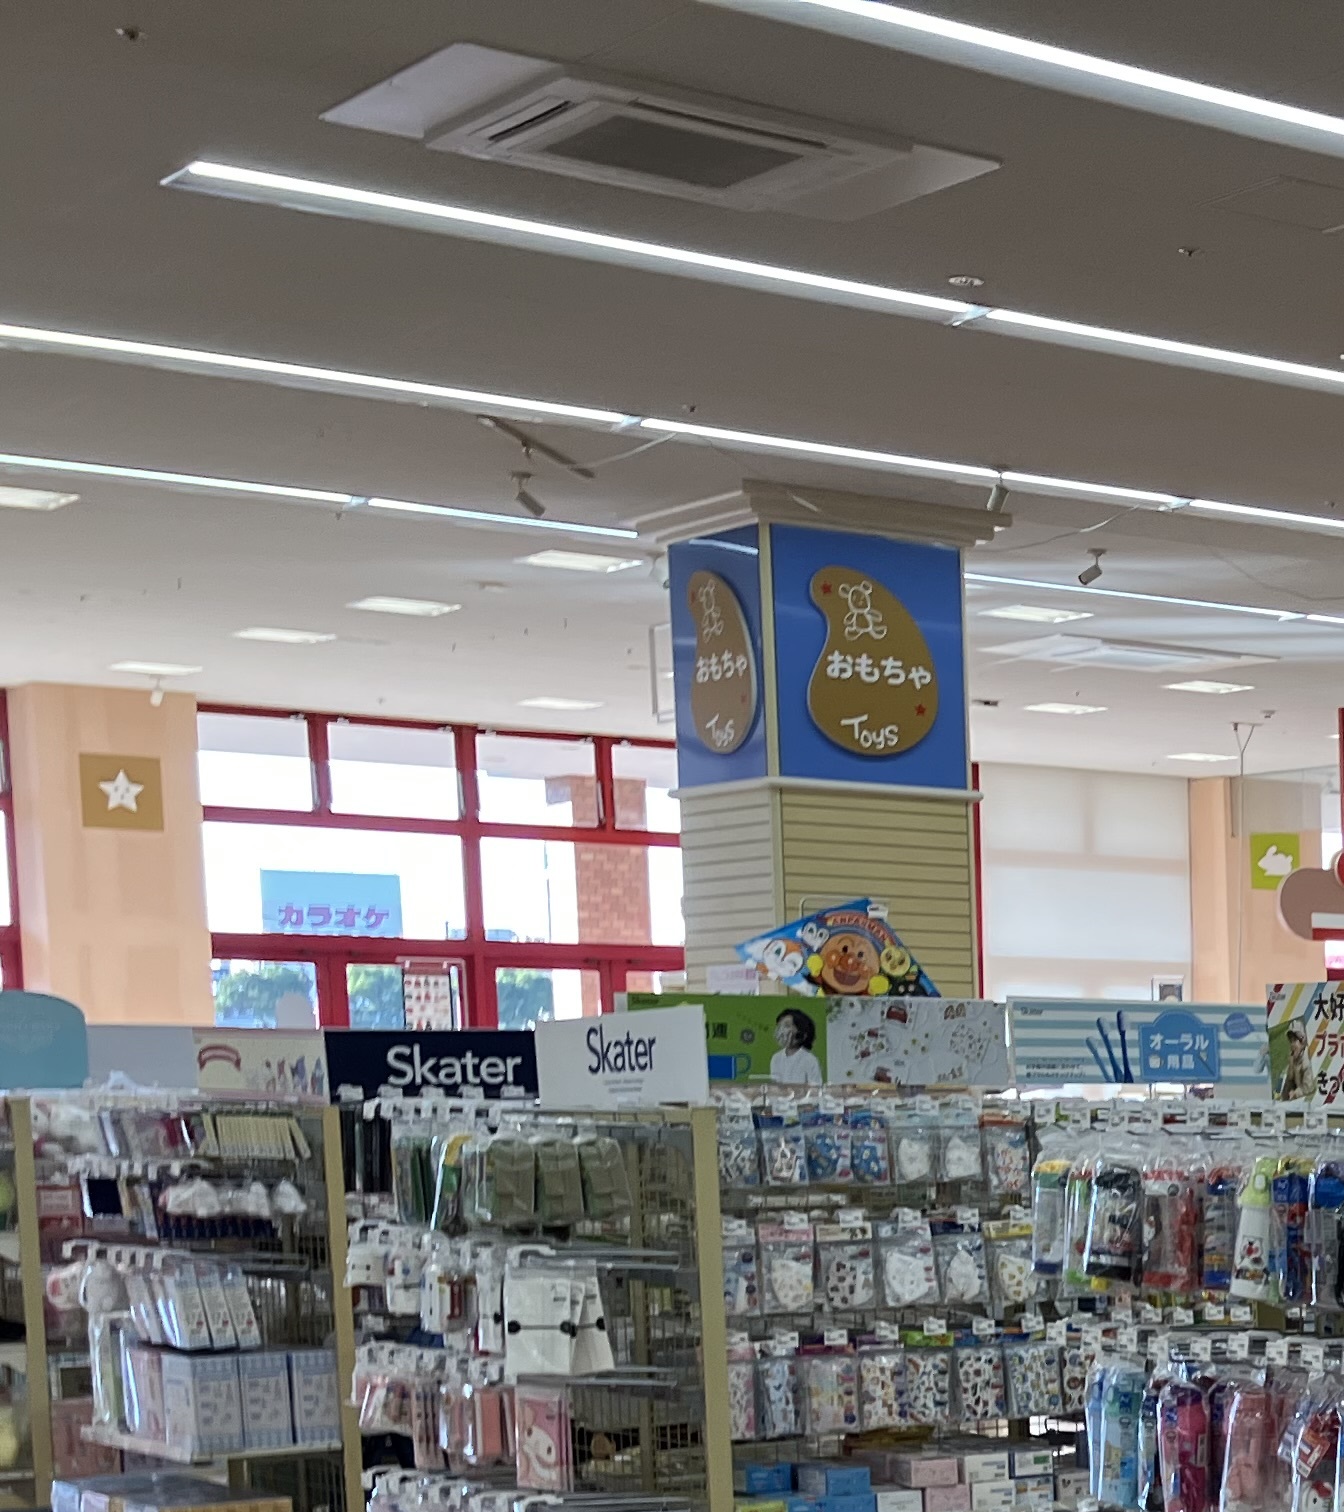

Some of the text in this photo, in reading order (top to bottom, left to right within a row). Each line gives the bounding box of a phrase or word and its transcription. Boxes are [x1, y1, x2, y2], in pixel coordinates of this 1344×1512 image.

[695, 650, 748, 684] おもちゃ
[826, 649, 932, 690] おもちゃ
[706, 712, 735, 747] Toys
[840, 714, 898, 750] Toys
[277, 903, 390, 929] カラオケ
[585, 1023, 658, 1076] Skater
[1149, 1033, 1209, 1051] オーラル
[386, 1043, 522, 1087] Skater
[1167, 1054, 1195, 1070] 用品
